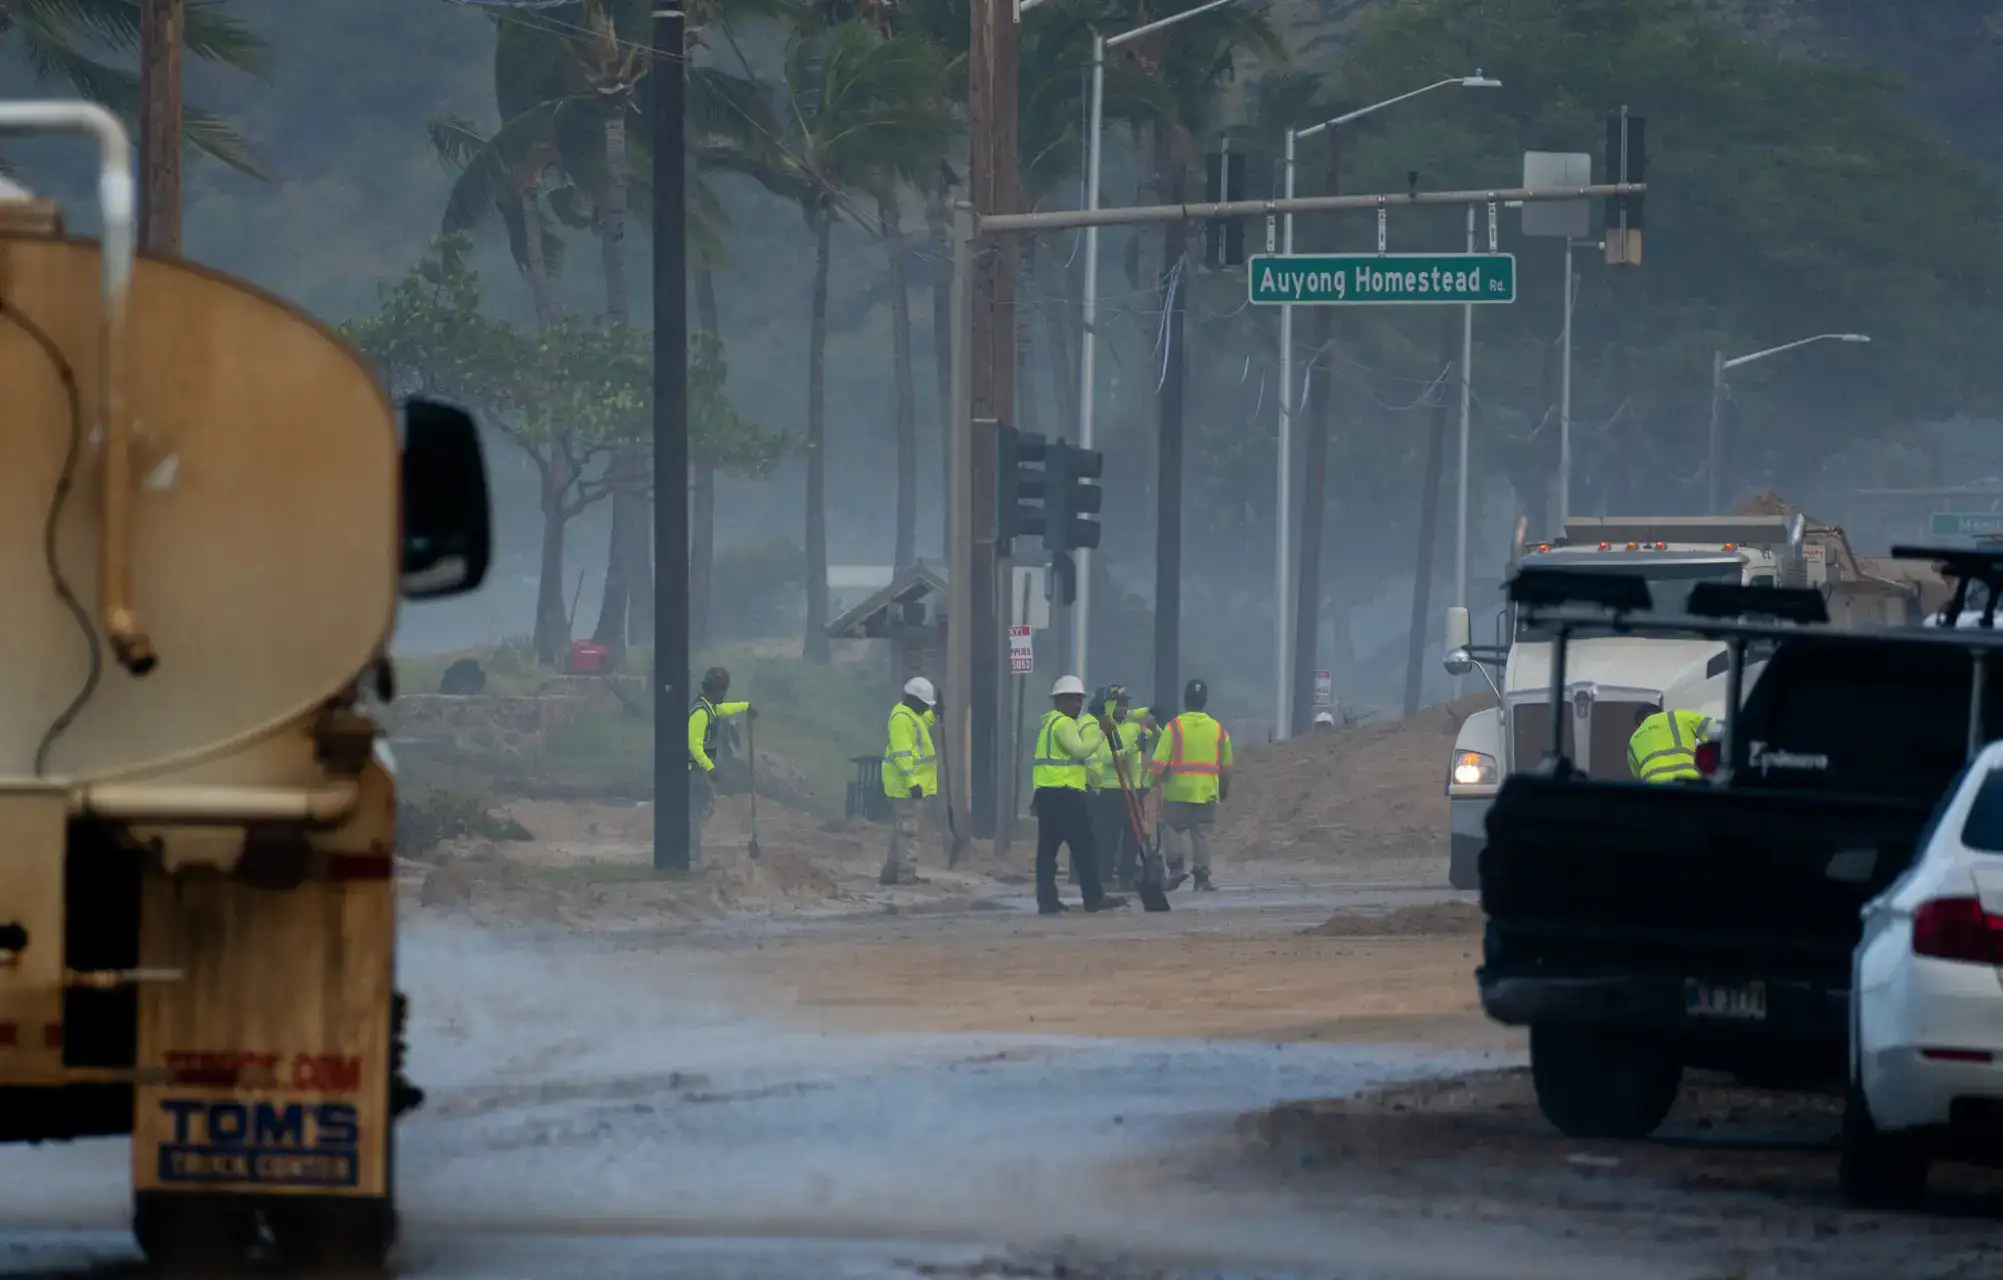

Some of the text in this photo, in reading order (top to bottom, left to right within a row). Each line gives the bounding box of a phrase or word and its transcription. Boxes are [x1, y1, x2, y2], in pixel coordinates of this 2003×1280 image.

[1260, 266, 1346, 299] Auyong
[1355, 265, 1480, 292] Homestead
[161, 1100, 358, 1146] TOM'S
